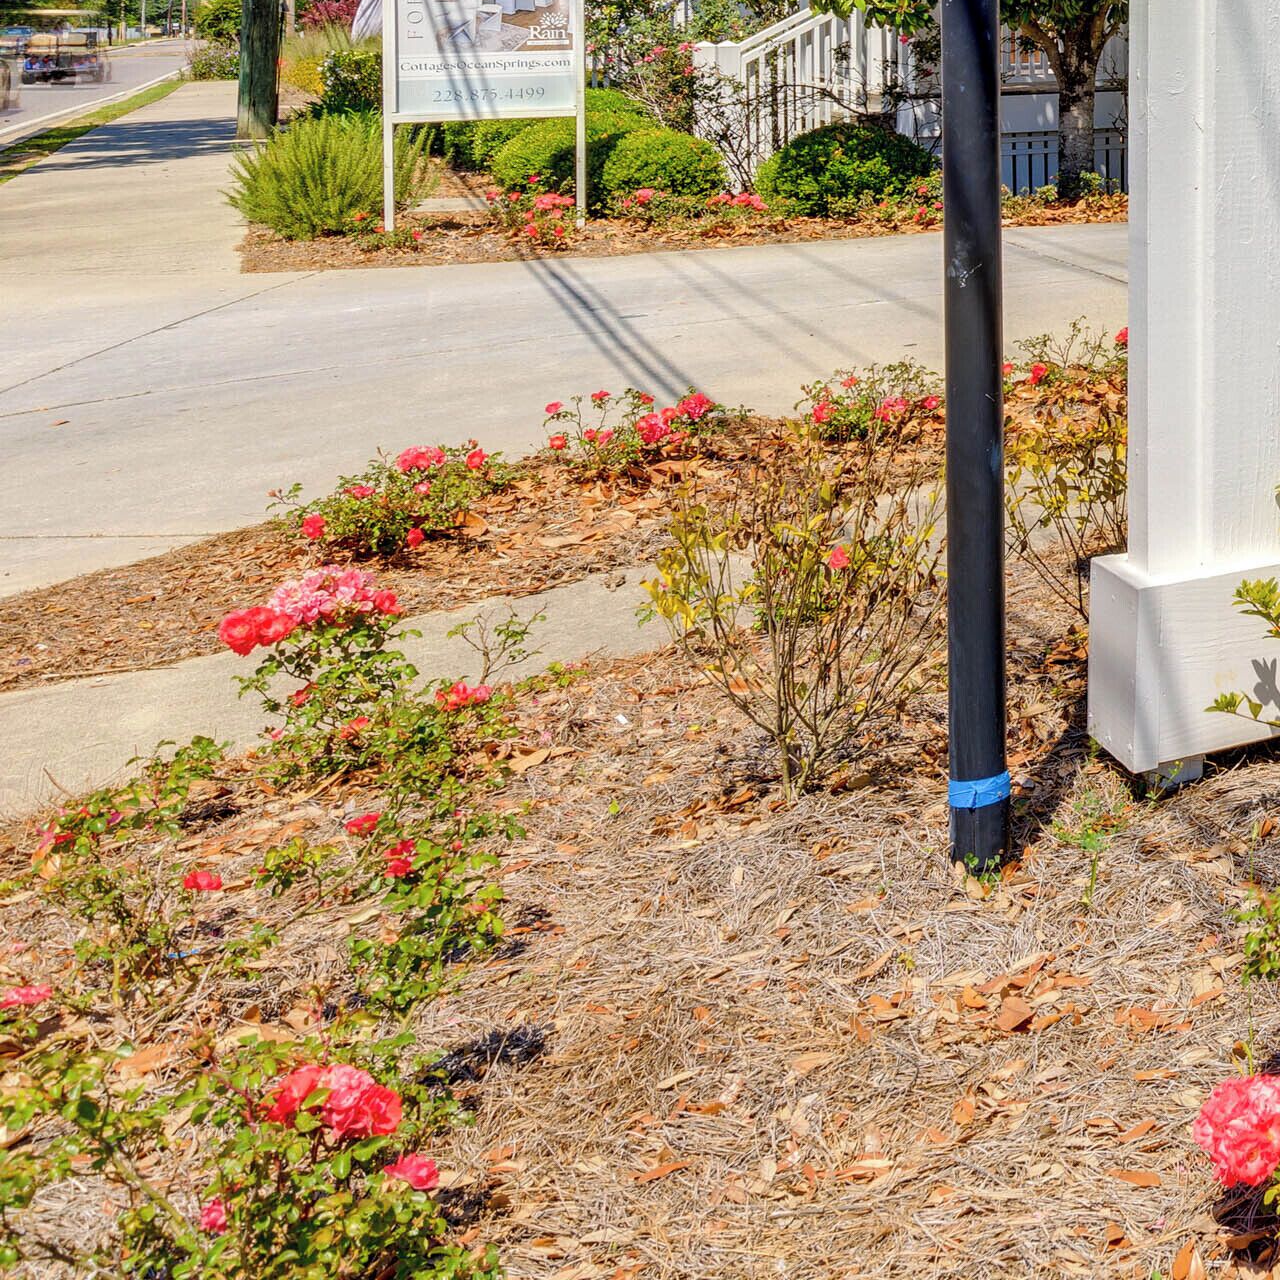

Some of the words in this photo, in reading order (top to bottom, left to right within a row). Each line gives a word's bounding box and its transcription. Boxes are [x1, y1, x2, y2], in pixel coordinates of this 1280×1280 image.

[528, 25, 568, 39] Rain
[400, 57, 571, 73] CottagesOceanSprings.com
[432, 86, 546, 103] 228.875.4499
